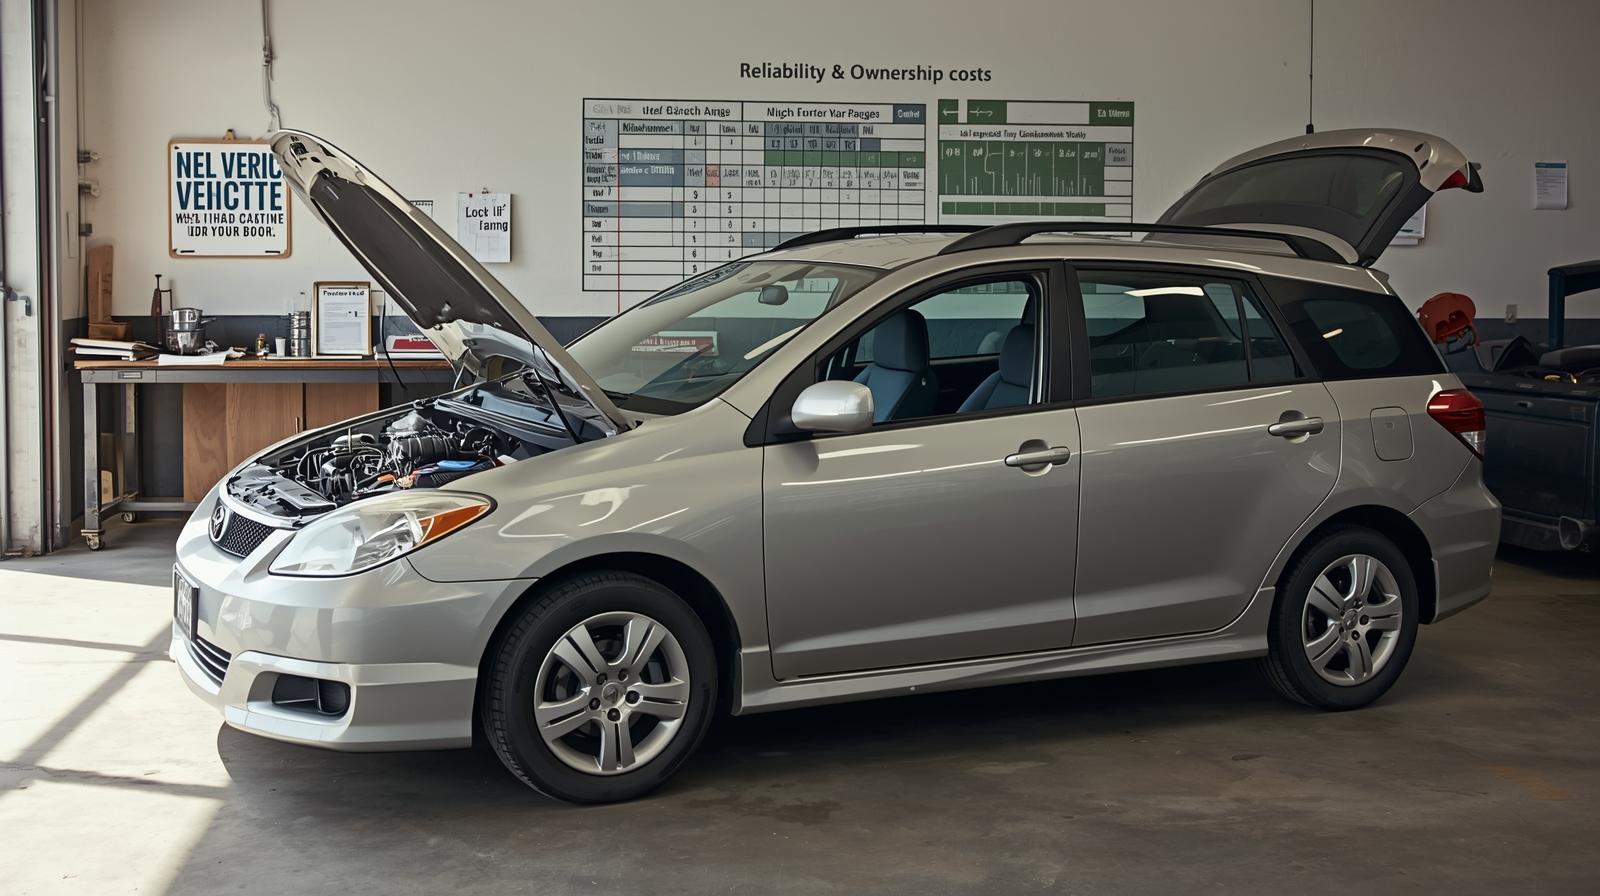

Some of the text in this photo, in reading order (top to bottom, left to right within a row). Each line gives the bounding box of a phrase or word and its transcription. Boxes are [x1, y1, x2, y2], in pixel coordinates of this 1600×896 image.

[740, 62, 993, 85] Reliability & Ownership costs
[176, 151, 217, 179] NEL
[465, 206, 489, 218] Lock
[211, 225, 240, 238] YOUR
